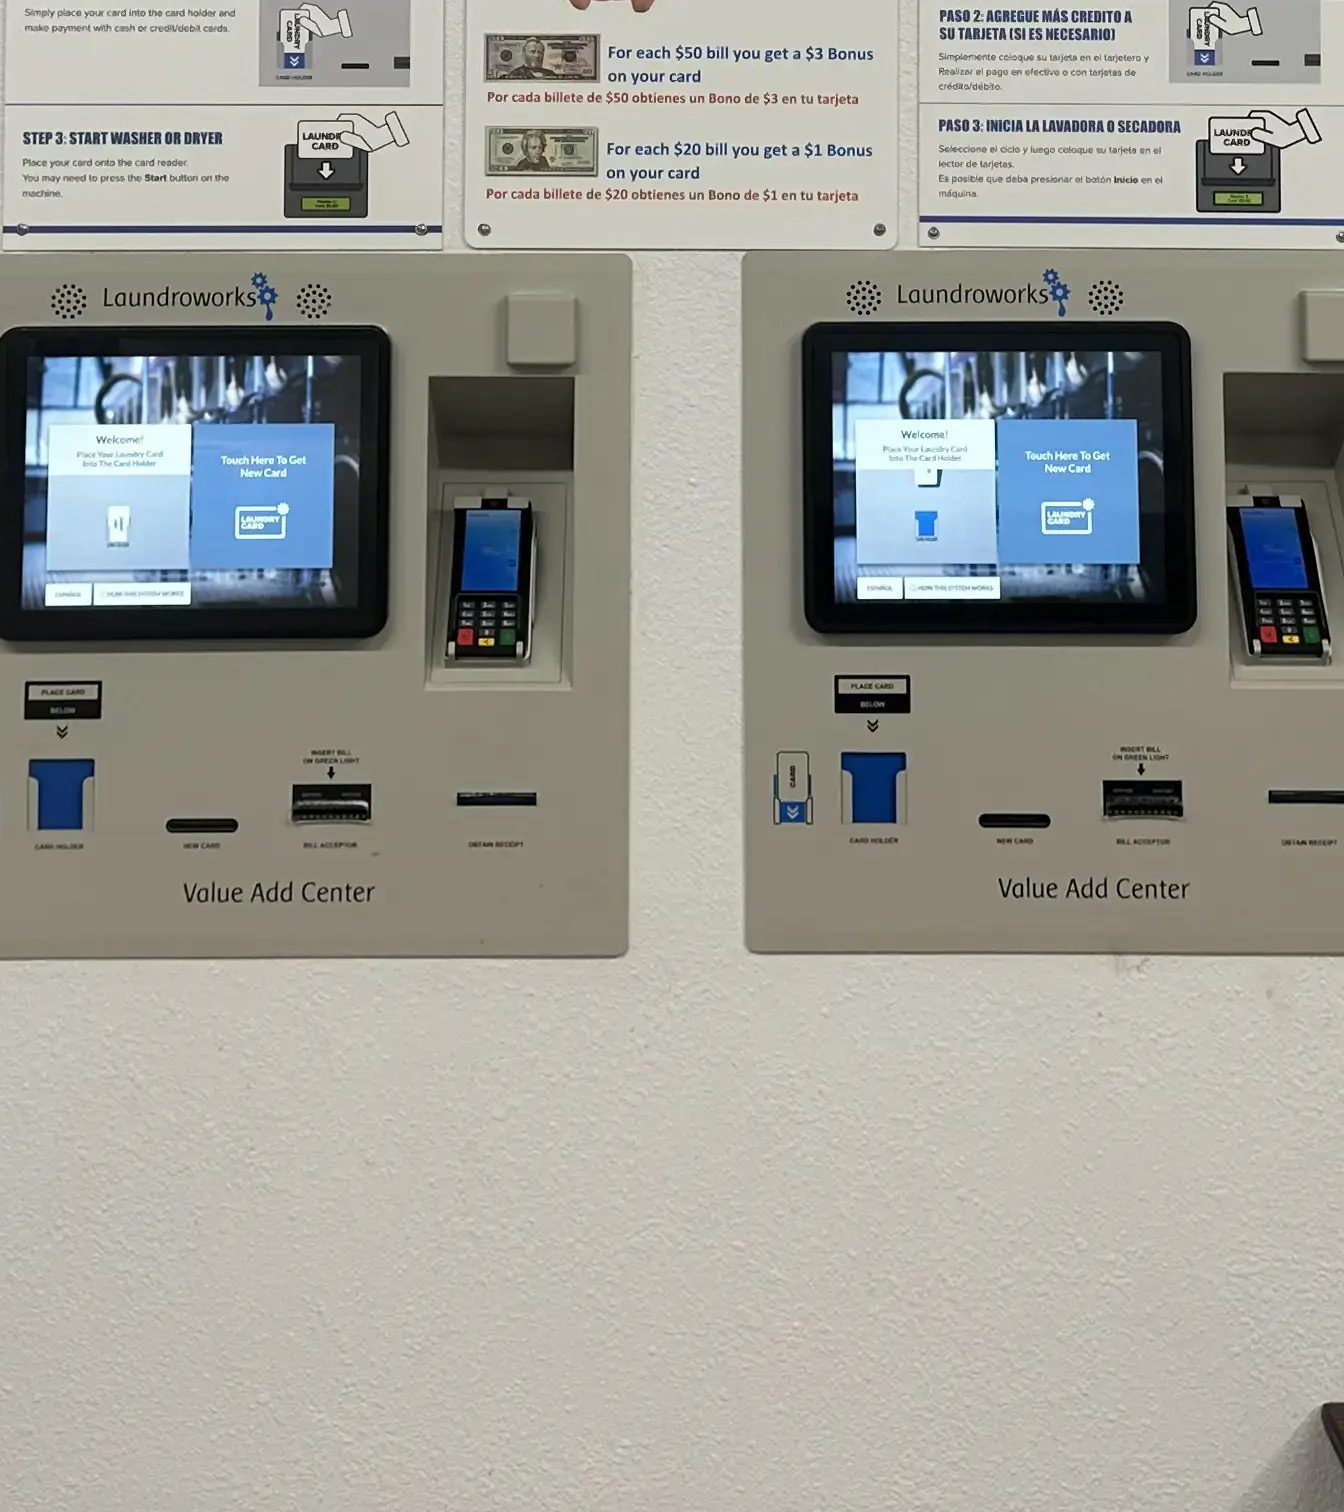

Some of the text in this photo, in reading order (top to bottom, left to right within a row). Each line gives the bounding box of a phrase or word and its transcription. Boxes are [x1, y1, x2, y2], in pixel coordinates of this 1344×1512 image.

[939, 9, 970, 22] PASO
[985, 9, 1039, 23] AGREGUE
[1041, 7, 1068, 23] MÁS
[1071, 10, 1121, 23] CREDITO
[1123, 10, 1132, 23] A
[939, 26, 1115, 41] SU TARJETA (SI ES NECESARIO)
[608, 44, 873, 63] For each $50 bill you get a $3 Bonus
[607, 69, 701, 85] on your card
[487, 90, 858, 107] Por cada billete de $50 obtienes un Bono de $3 en tu tarjeta
[938, 118, 969, 132] PASO
[986, 119, 1023, 132] INICIA
[1025, 119, 1040, 132] LA
[1042, 119, 1104, 133] LAVADORA
[1106, 119, 1115, 133] O
[1117, 119, 1181, 133] SECADORA
[22, 131, 52, 145] STEP
[69, 131, 108, 145] START
[110, 131, 161, 145] WASHER
[164, 131, 181, 145] OR
[184, 131, 222, 145] DRYER
[606, 140, 872, 159] For each $20 bill you get a $1 Bonus
[606, 165, 699, 182] on your card
[103, 286, 258, 308] Laundroworks
[897, 283, 1049, 304] Laundroworks
[1024, 450, 1110, 460] Touch Here To Get
[1044, 463, 1091, 473] New Card
[183, 880, 375, 903] Value Add Center
[998, 876, 1189, 899] Value Add Center
